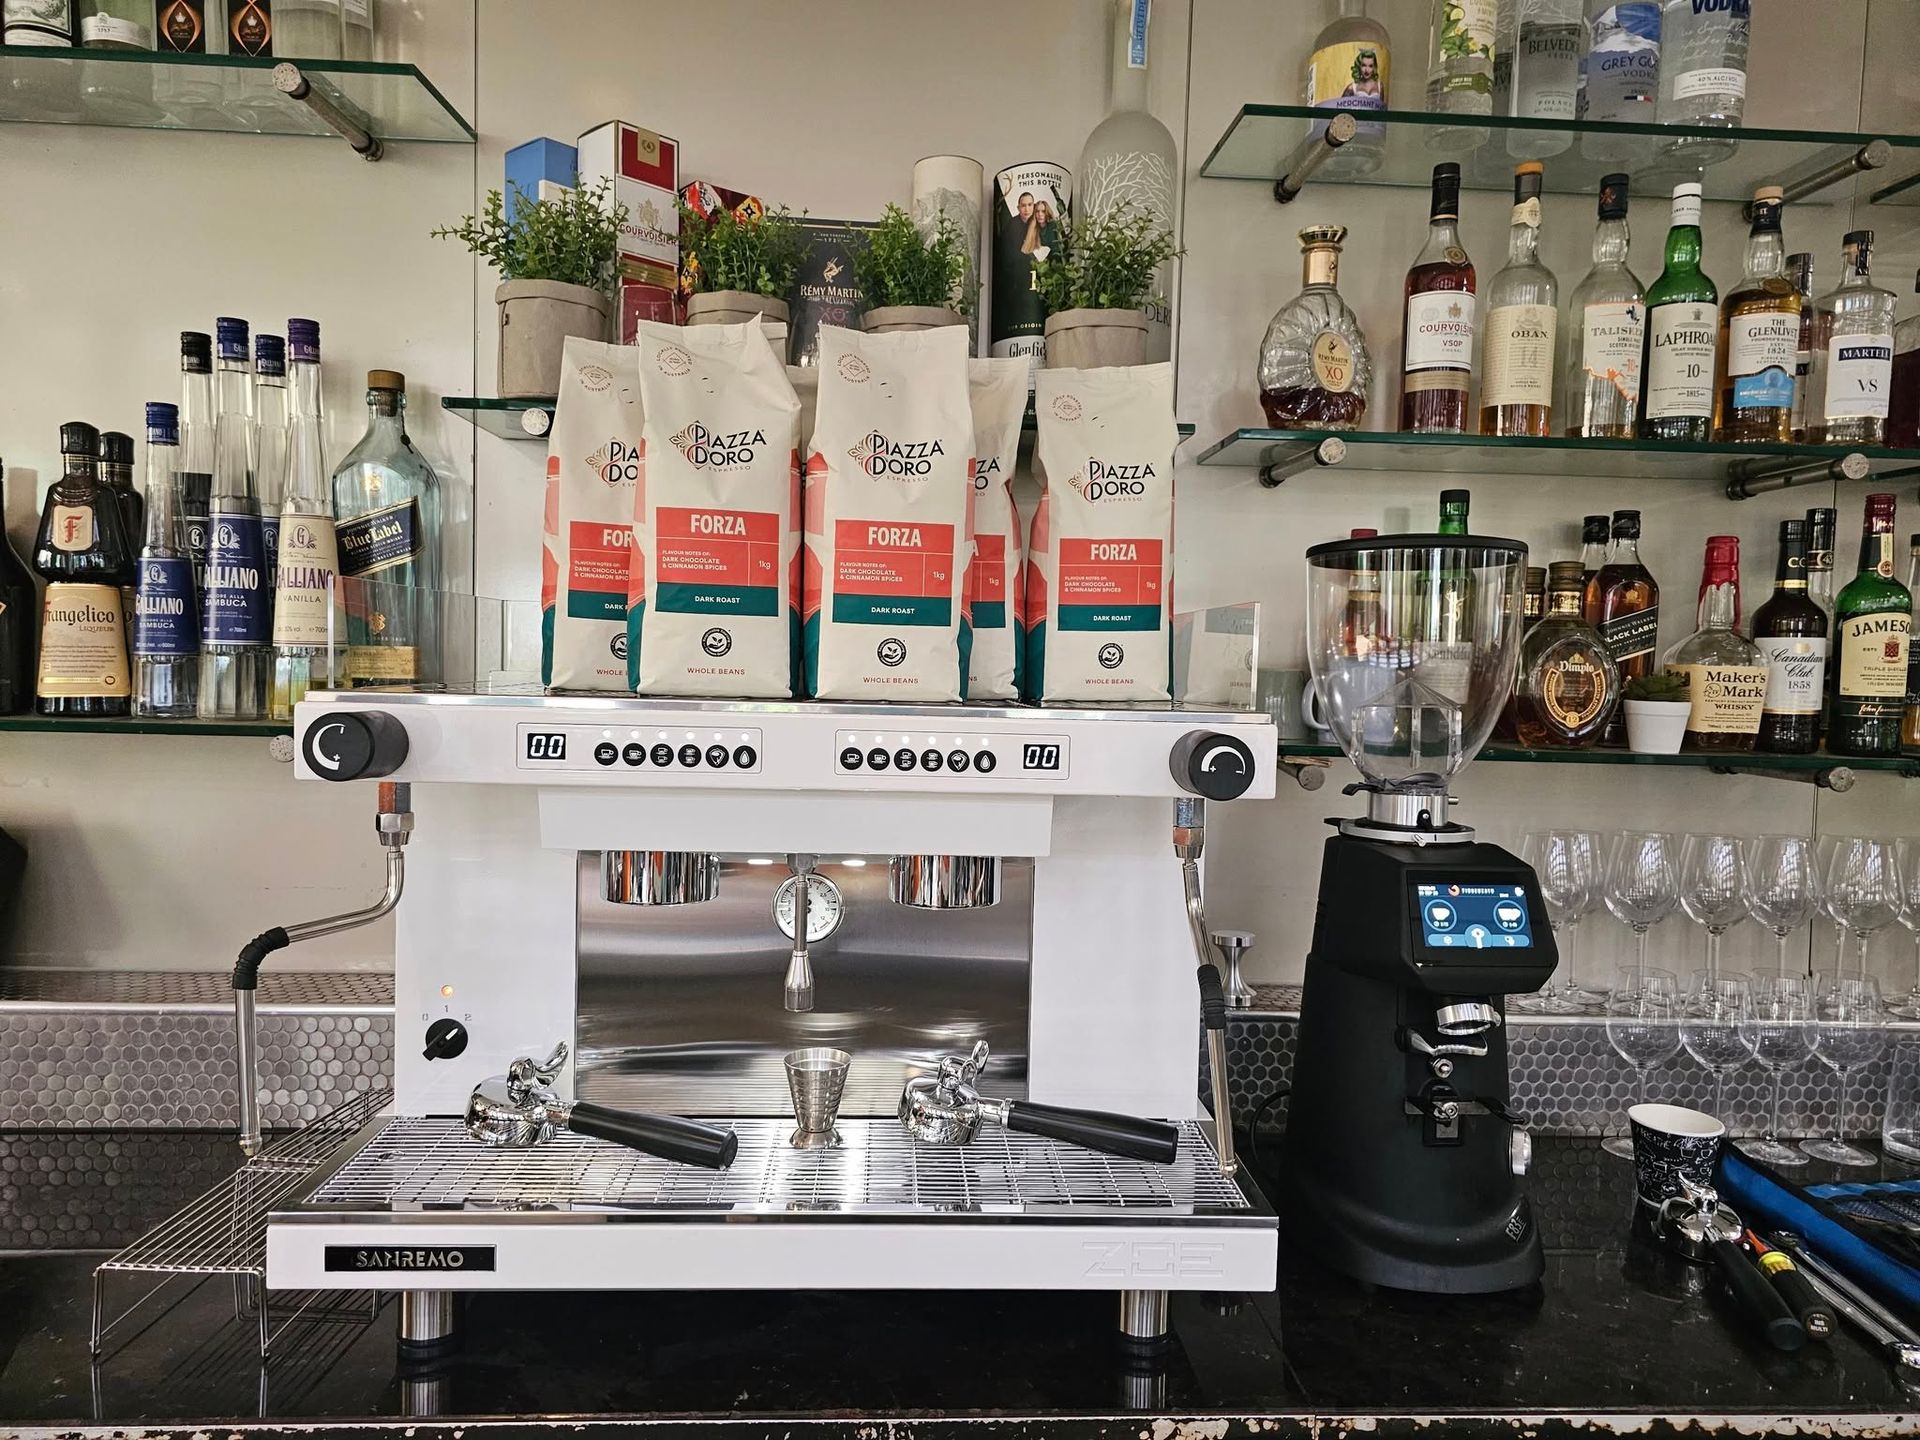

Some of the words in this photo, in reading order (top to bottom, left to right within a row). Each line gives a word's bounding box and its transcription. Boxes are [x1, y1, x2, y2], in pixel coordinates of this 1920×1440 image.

[1602, 56, 1636, 71] GREY
[1018, 172, 1062, 182] PERSONALISE
[1037, 180, 1061, 189] BOTTLE
[800, 284, 826, 296] RÉMY
[1511, 330, 1548, 338] OBAN
[1325, 366, 1343, 380] XO
[1687, 364, 1700, 378] 10
[1858, 379, 1878, 393] VS
[695, 424, 767, 450] PIAZZA
[873, 434, 944, 459] PIAZZA
[1090, 461, 1156, 480] PIAZZA
[690, 514, 746, 536] FORZA
[342, 534, 370, 551] Blue
[369, 520, 403, 543] Label
[868, 526, 922, 547] FORZA
[1090, 544, 1137, 561] FORZA
[758, 560, 771, 570] 1kg
[933, 571, 945, 581] 1kg
[989, 578, 999, 586] 1kg
[284, 595, 321, 603] VANILLA
[1771, 648, 1823, 663] Canadian
[1705, 671, 1766, 683] Maker's
[1722, 686, 1763, 698] Mark
[1788, 681, 1811, 689] 1858
[529, 735, 564, 758] 00
[1026, 746, 1056, 767] 00
[356, 1250, 464, 1268] SANREMO
